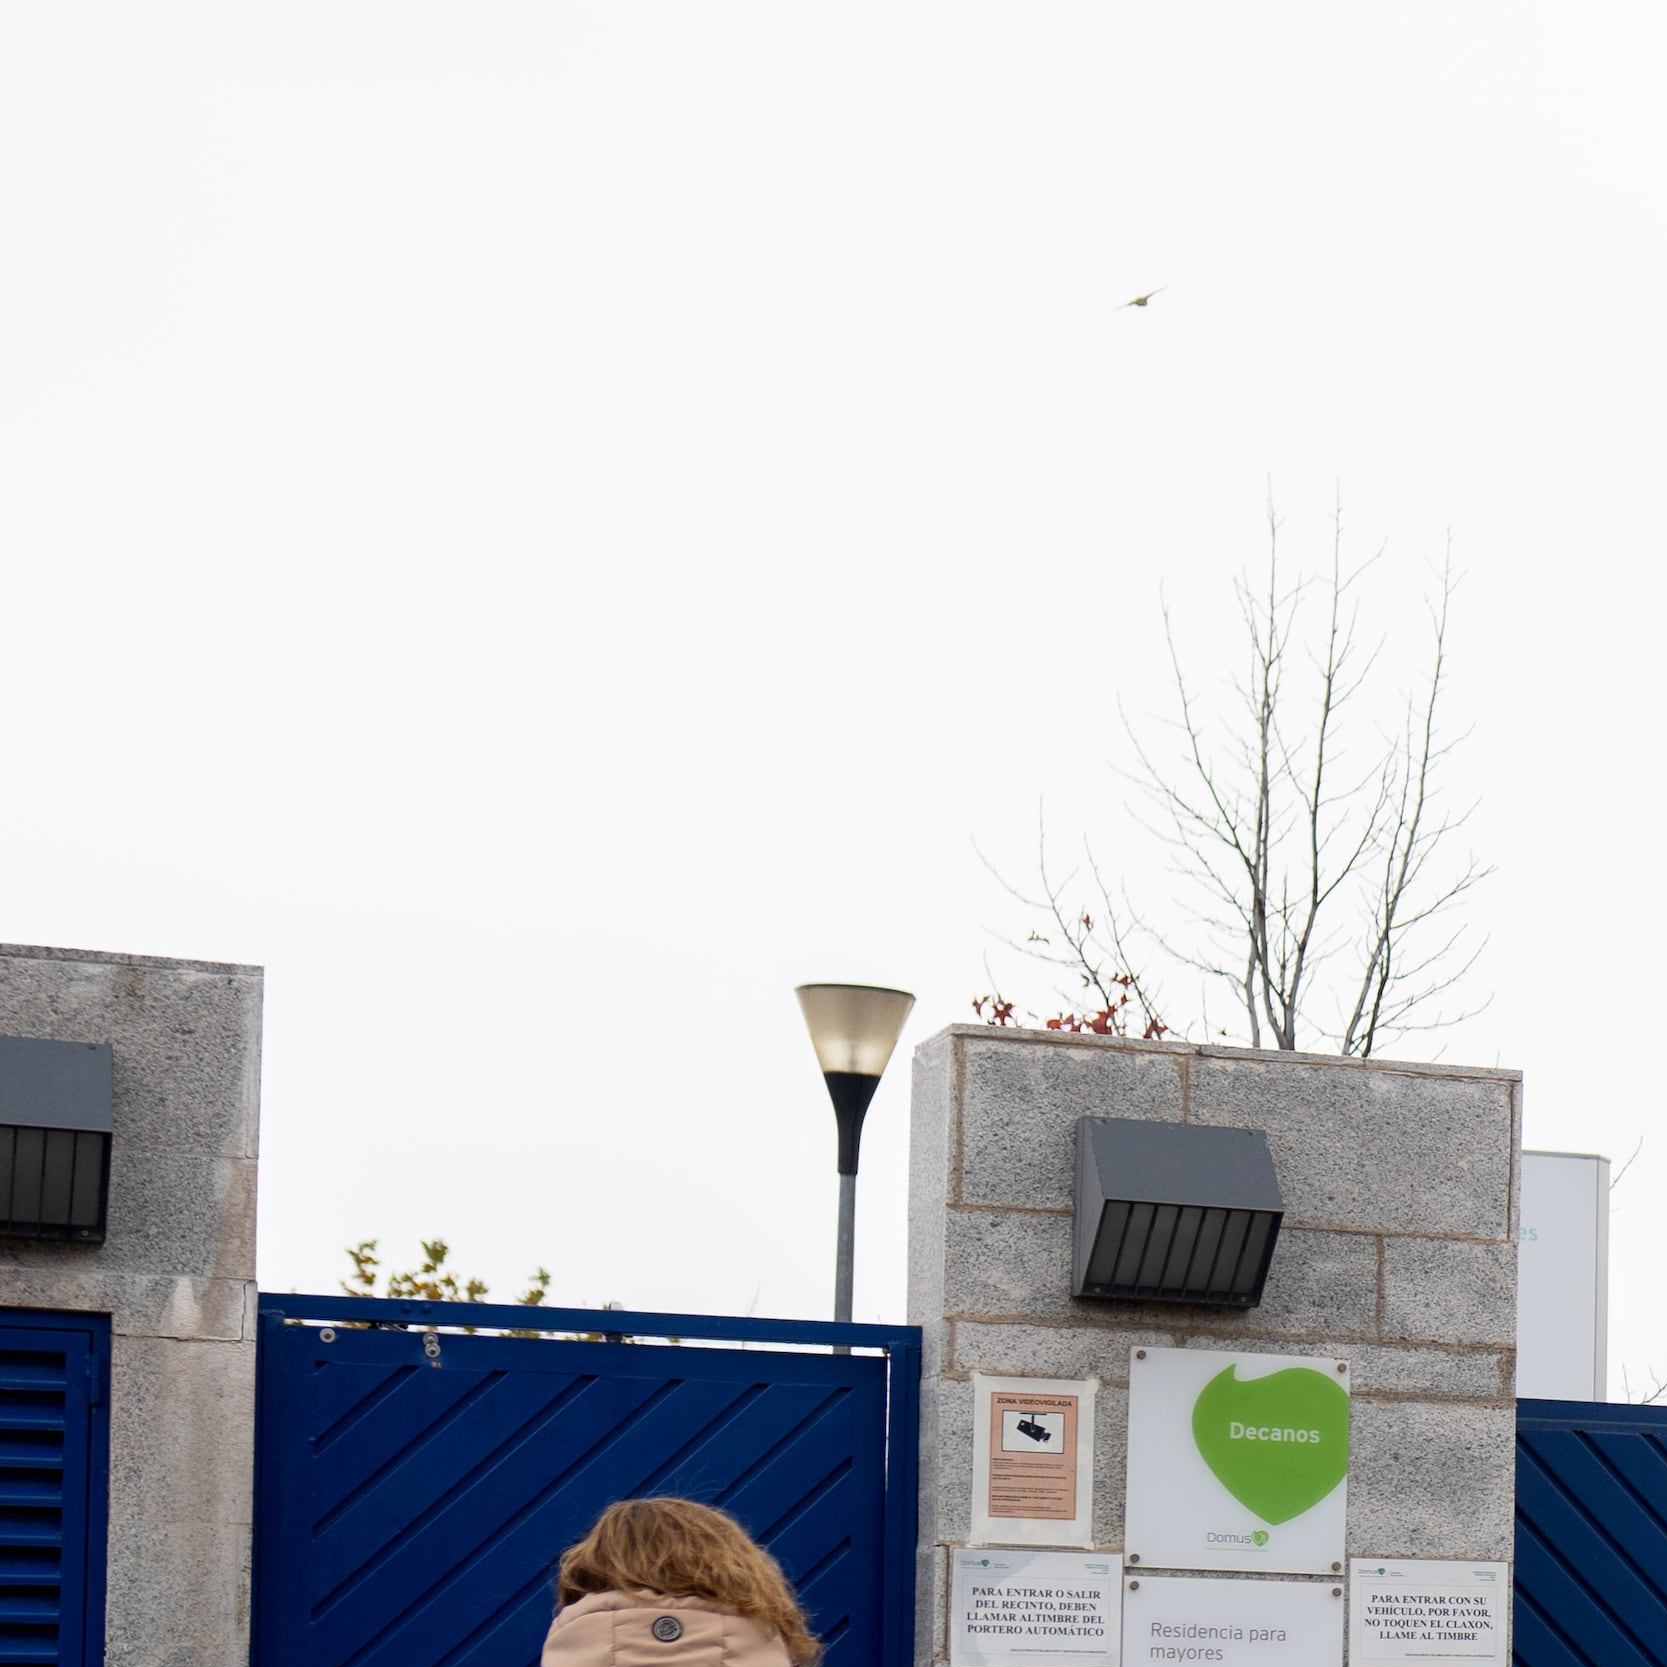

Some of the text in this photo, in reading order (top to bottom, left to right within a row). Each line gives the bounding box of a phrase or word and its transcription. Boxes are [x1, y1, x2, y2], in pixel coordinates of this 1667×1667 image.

[996, 1397, 1073, 1407] ZONA VIDEOVIGILADA
[1229, 1421, 1321, 1444] Decanos
[972, 1587, 1101, 1600] PARA ENTRAR O SALIR
[1371, 1594, 1487, 1606] PARA ENTRAR CON SU
[975, 1599, 1097, 1612] DEL RECINTO, DEBEN
[1428, 1607, 1450, 1617] POR
[966, 1612, 1017, 1622] LLAMAR
[1082, 1615, 1105, 1625] DEL
[1364, 1618, 1381, 1627] NO
[1382, 1619, 1428, 1629] TOQUEN
[1430, 1620, 1444, 1629] EL
[967, 1624, 1105, 1637] PORTERO AUTOMÁTICO
[1151, 1622, 1287, 1643] Residencia para
[1379, 1631, 1479, 1641] LLAME AL TIMBRE
[1150, 1645, 1224, 1663] mayores
